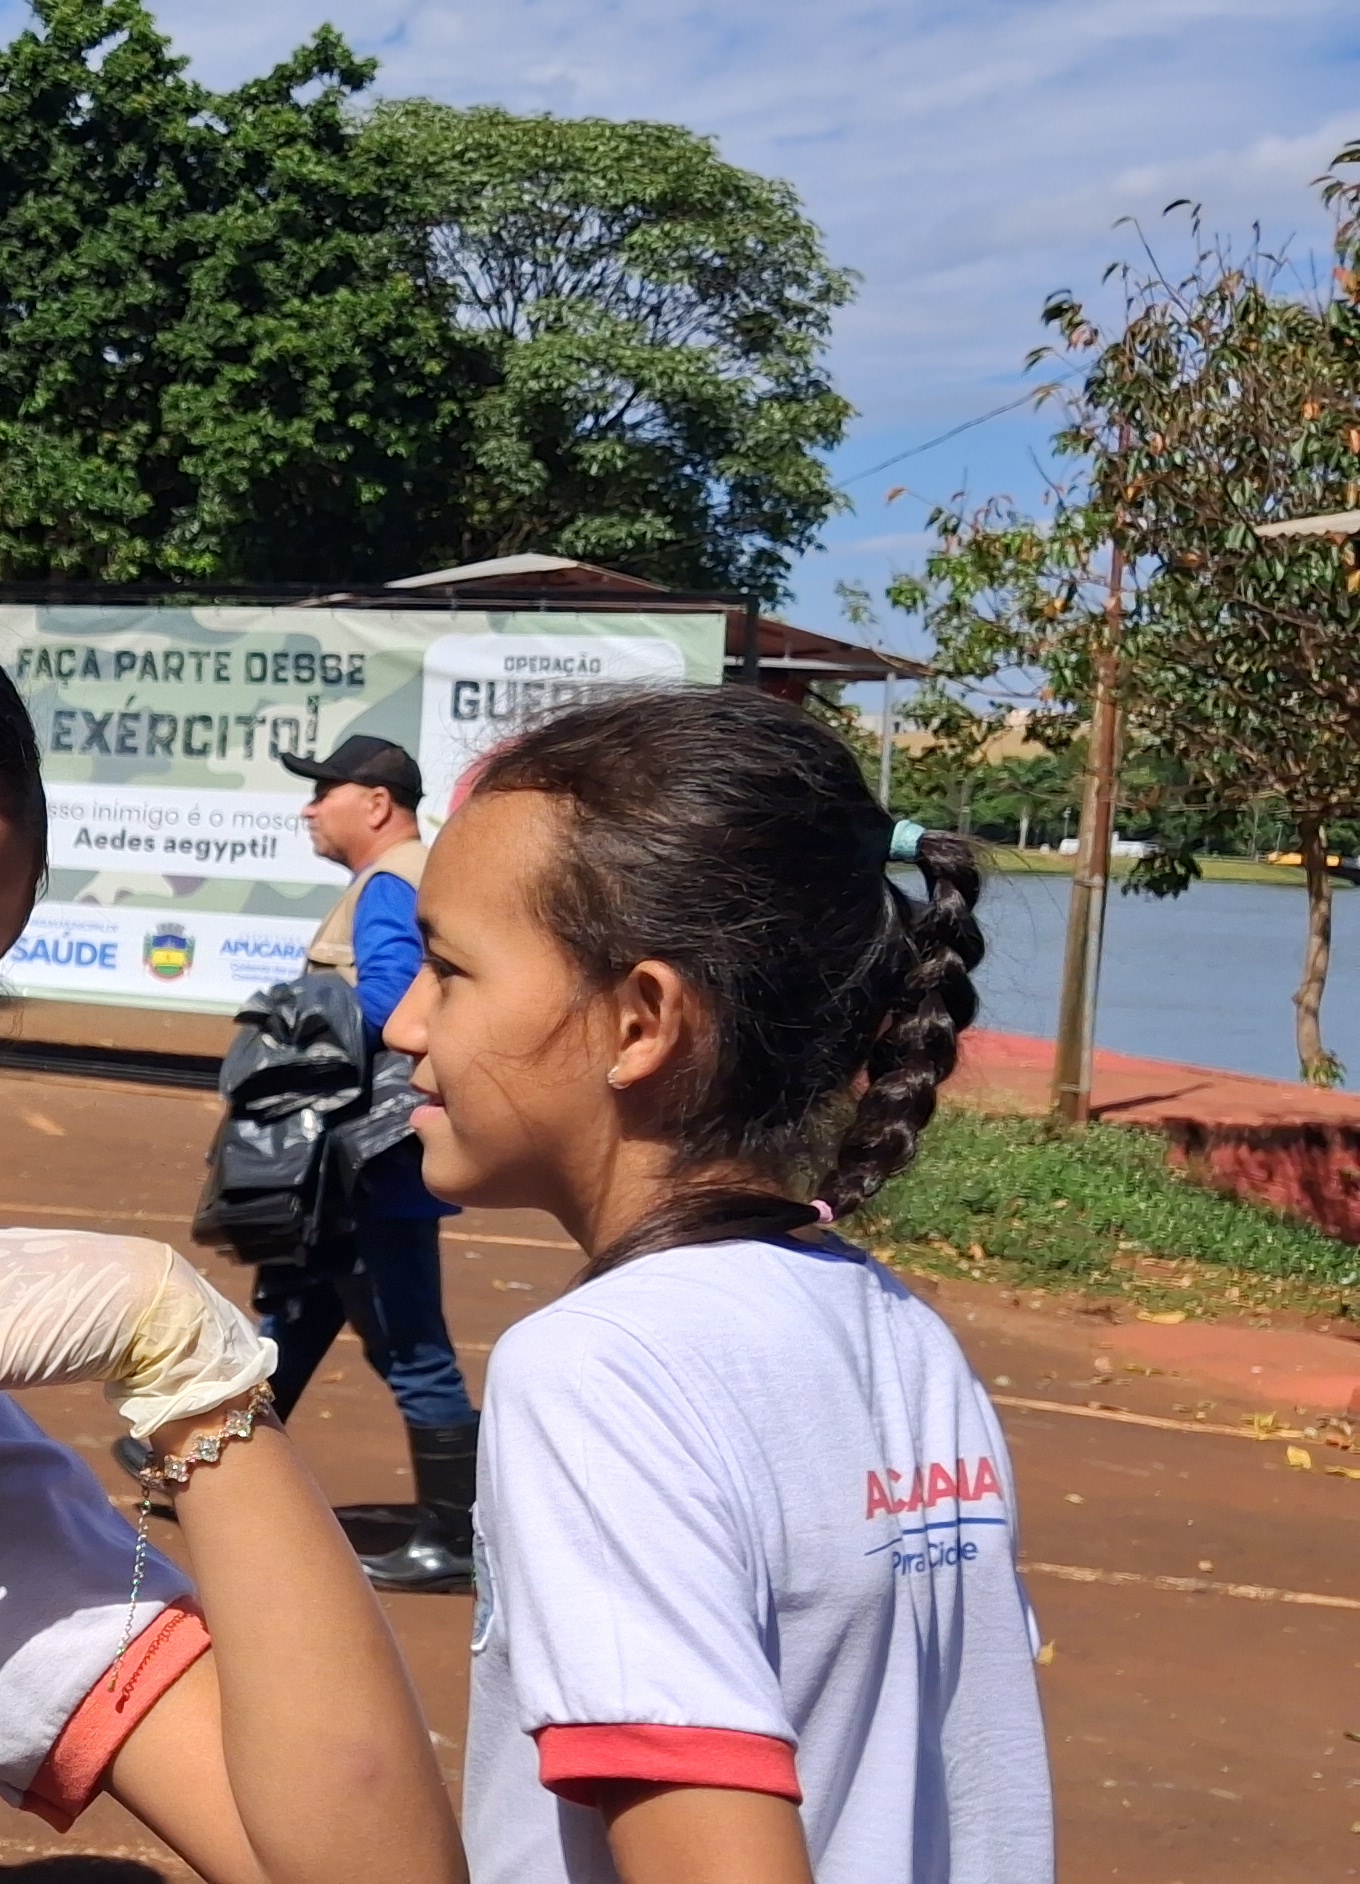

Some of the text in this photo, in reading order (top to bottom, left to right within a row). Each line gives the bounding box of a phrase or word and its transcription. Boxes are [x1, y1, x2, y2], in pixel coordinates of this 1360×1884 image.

[16, 648, 366, 689] FAÇA PARTE DESSE
[504, 652, 602, 677] OPERAÇÃO
[50, 694, 320, 760] EXÉRCITO!
[92, 802, 178, 830] inimigo
[187, 804, 202, 826] é
[209, 811, 224, 827] o
[74, 827, 279, 863] Aedes aegypti!
[11, 931, 118, 969] SAÚDE
